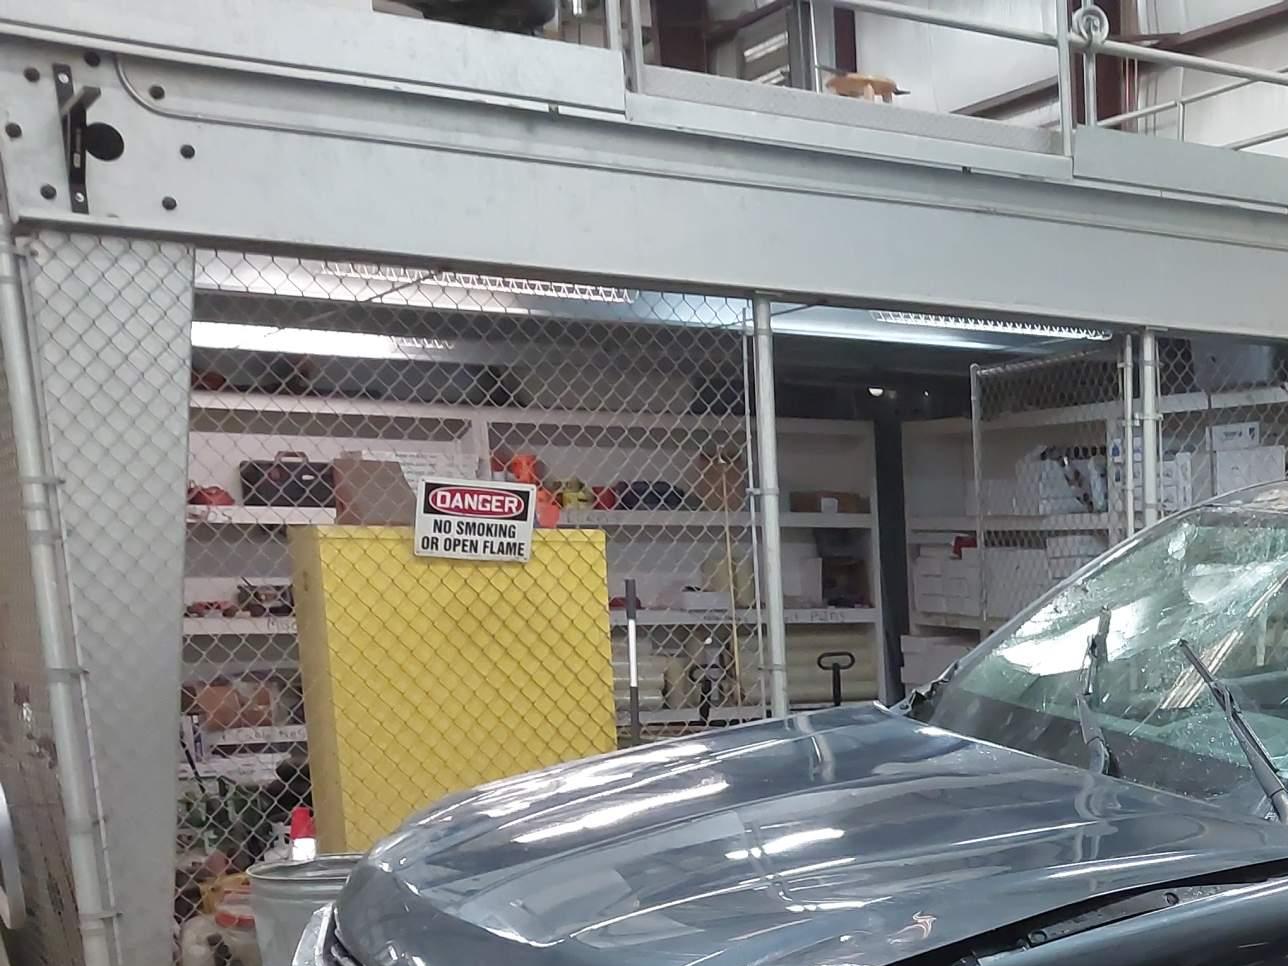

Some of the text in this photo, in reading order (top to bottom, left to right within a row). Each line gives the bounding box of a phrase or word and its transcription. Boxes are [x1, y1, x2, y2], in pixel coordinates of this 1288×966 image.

[436, 490, 518, 513] DANGER
[433, 519, 516, 539] NO SMOKING
[421, 536, 525, 557] OR OPEN FLAME
